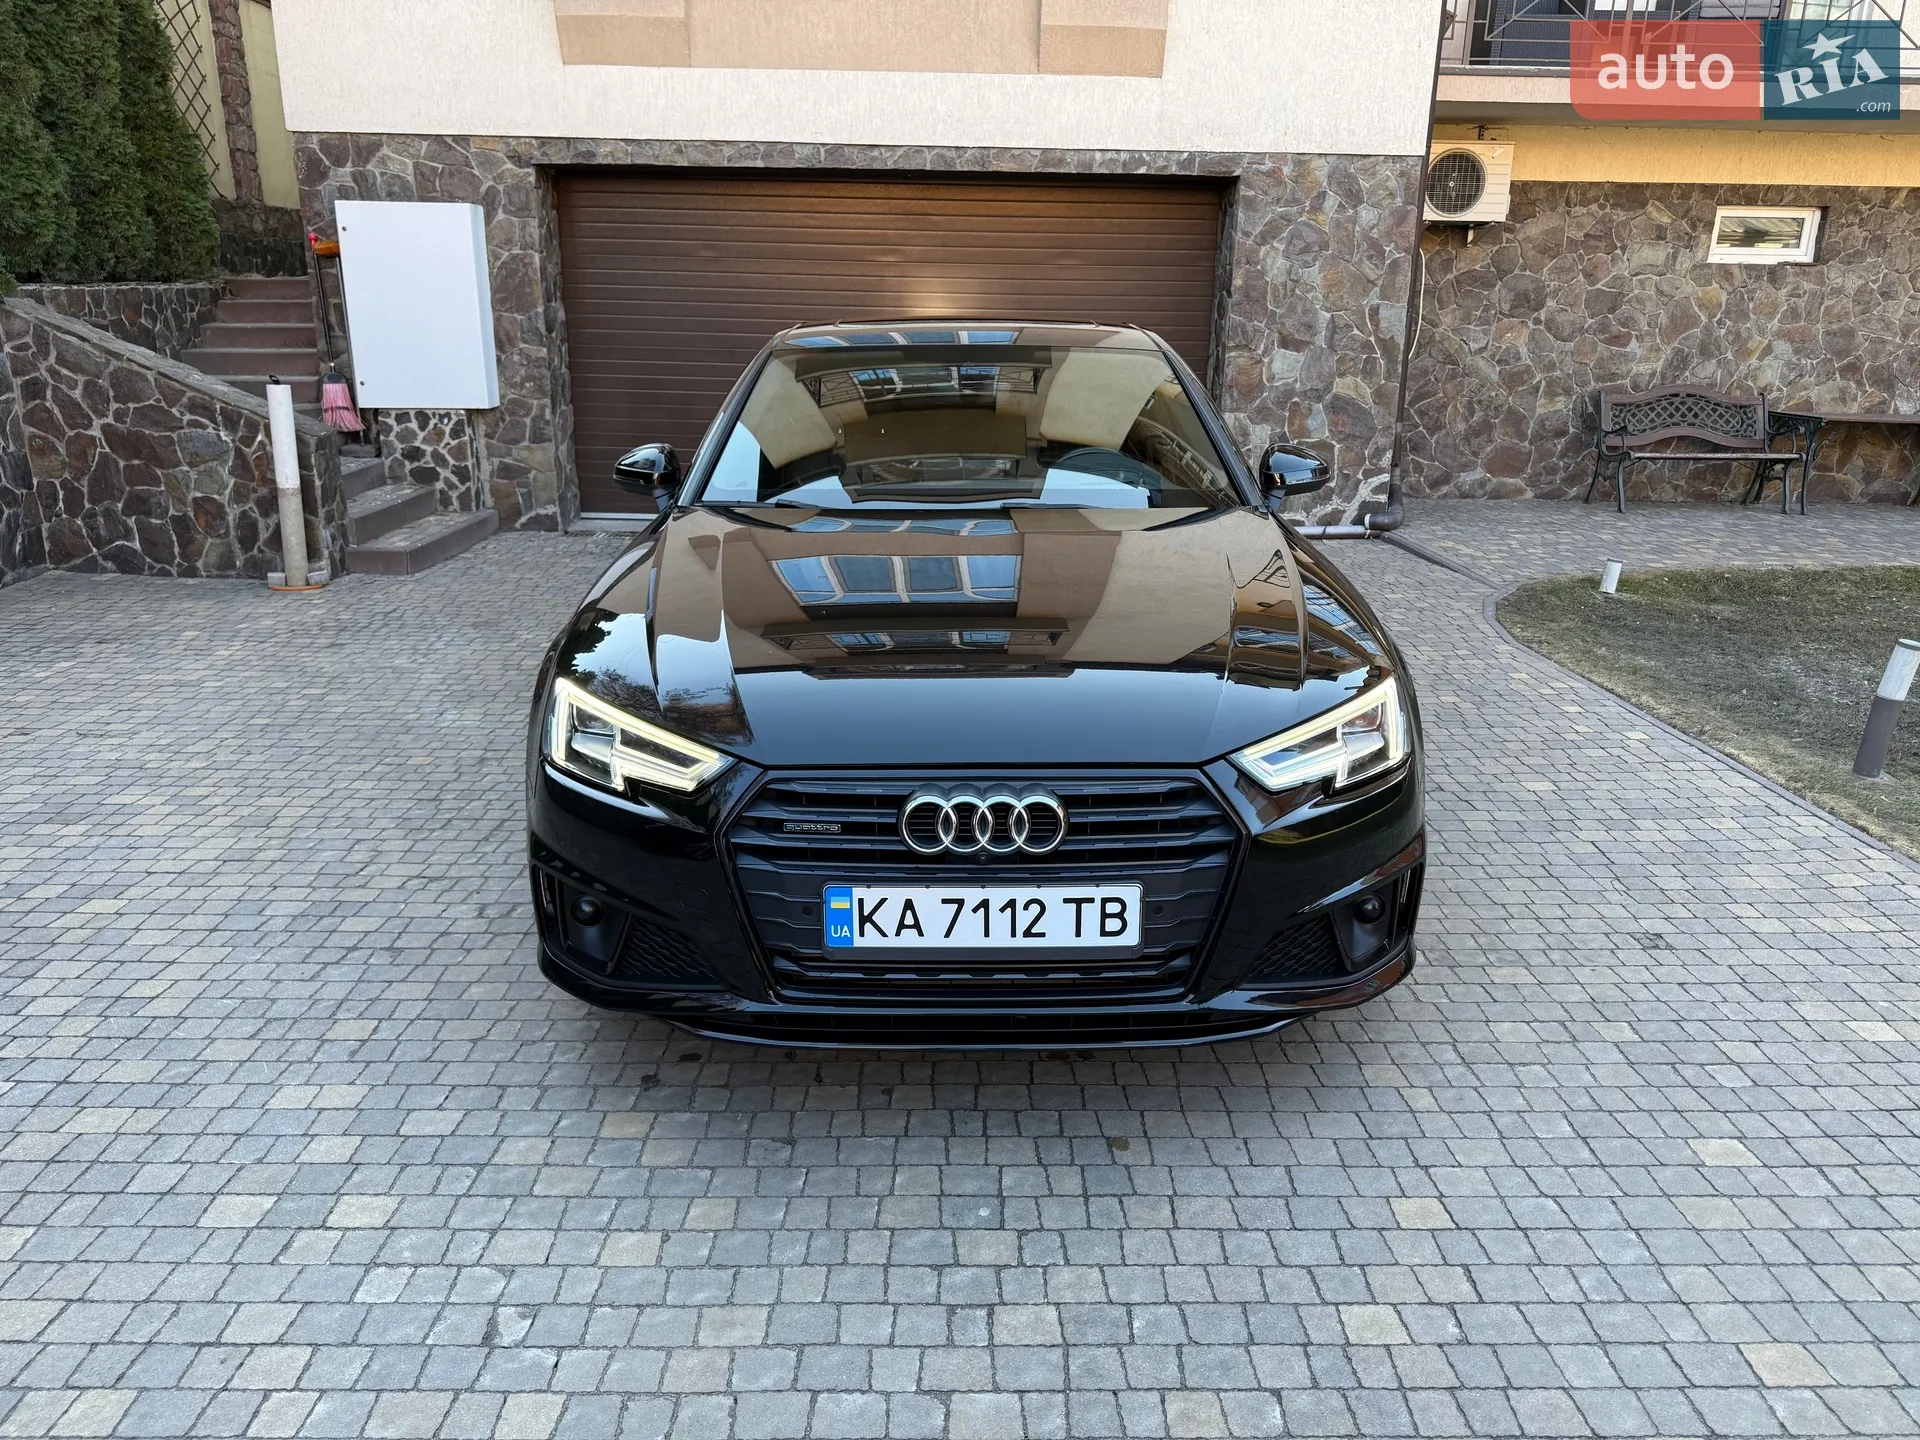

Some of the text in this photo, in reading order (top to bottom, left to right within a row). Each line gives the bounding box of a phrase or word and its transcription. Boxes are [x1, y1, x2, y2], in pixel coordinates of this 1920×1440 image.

[785, 823, 840, 832] quattro
[858, 897, 1128, 938] KA 7112 TB
[831, 924, 851, 938] UA
